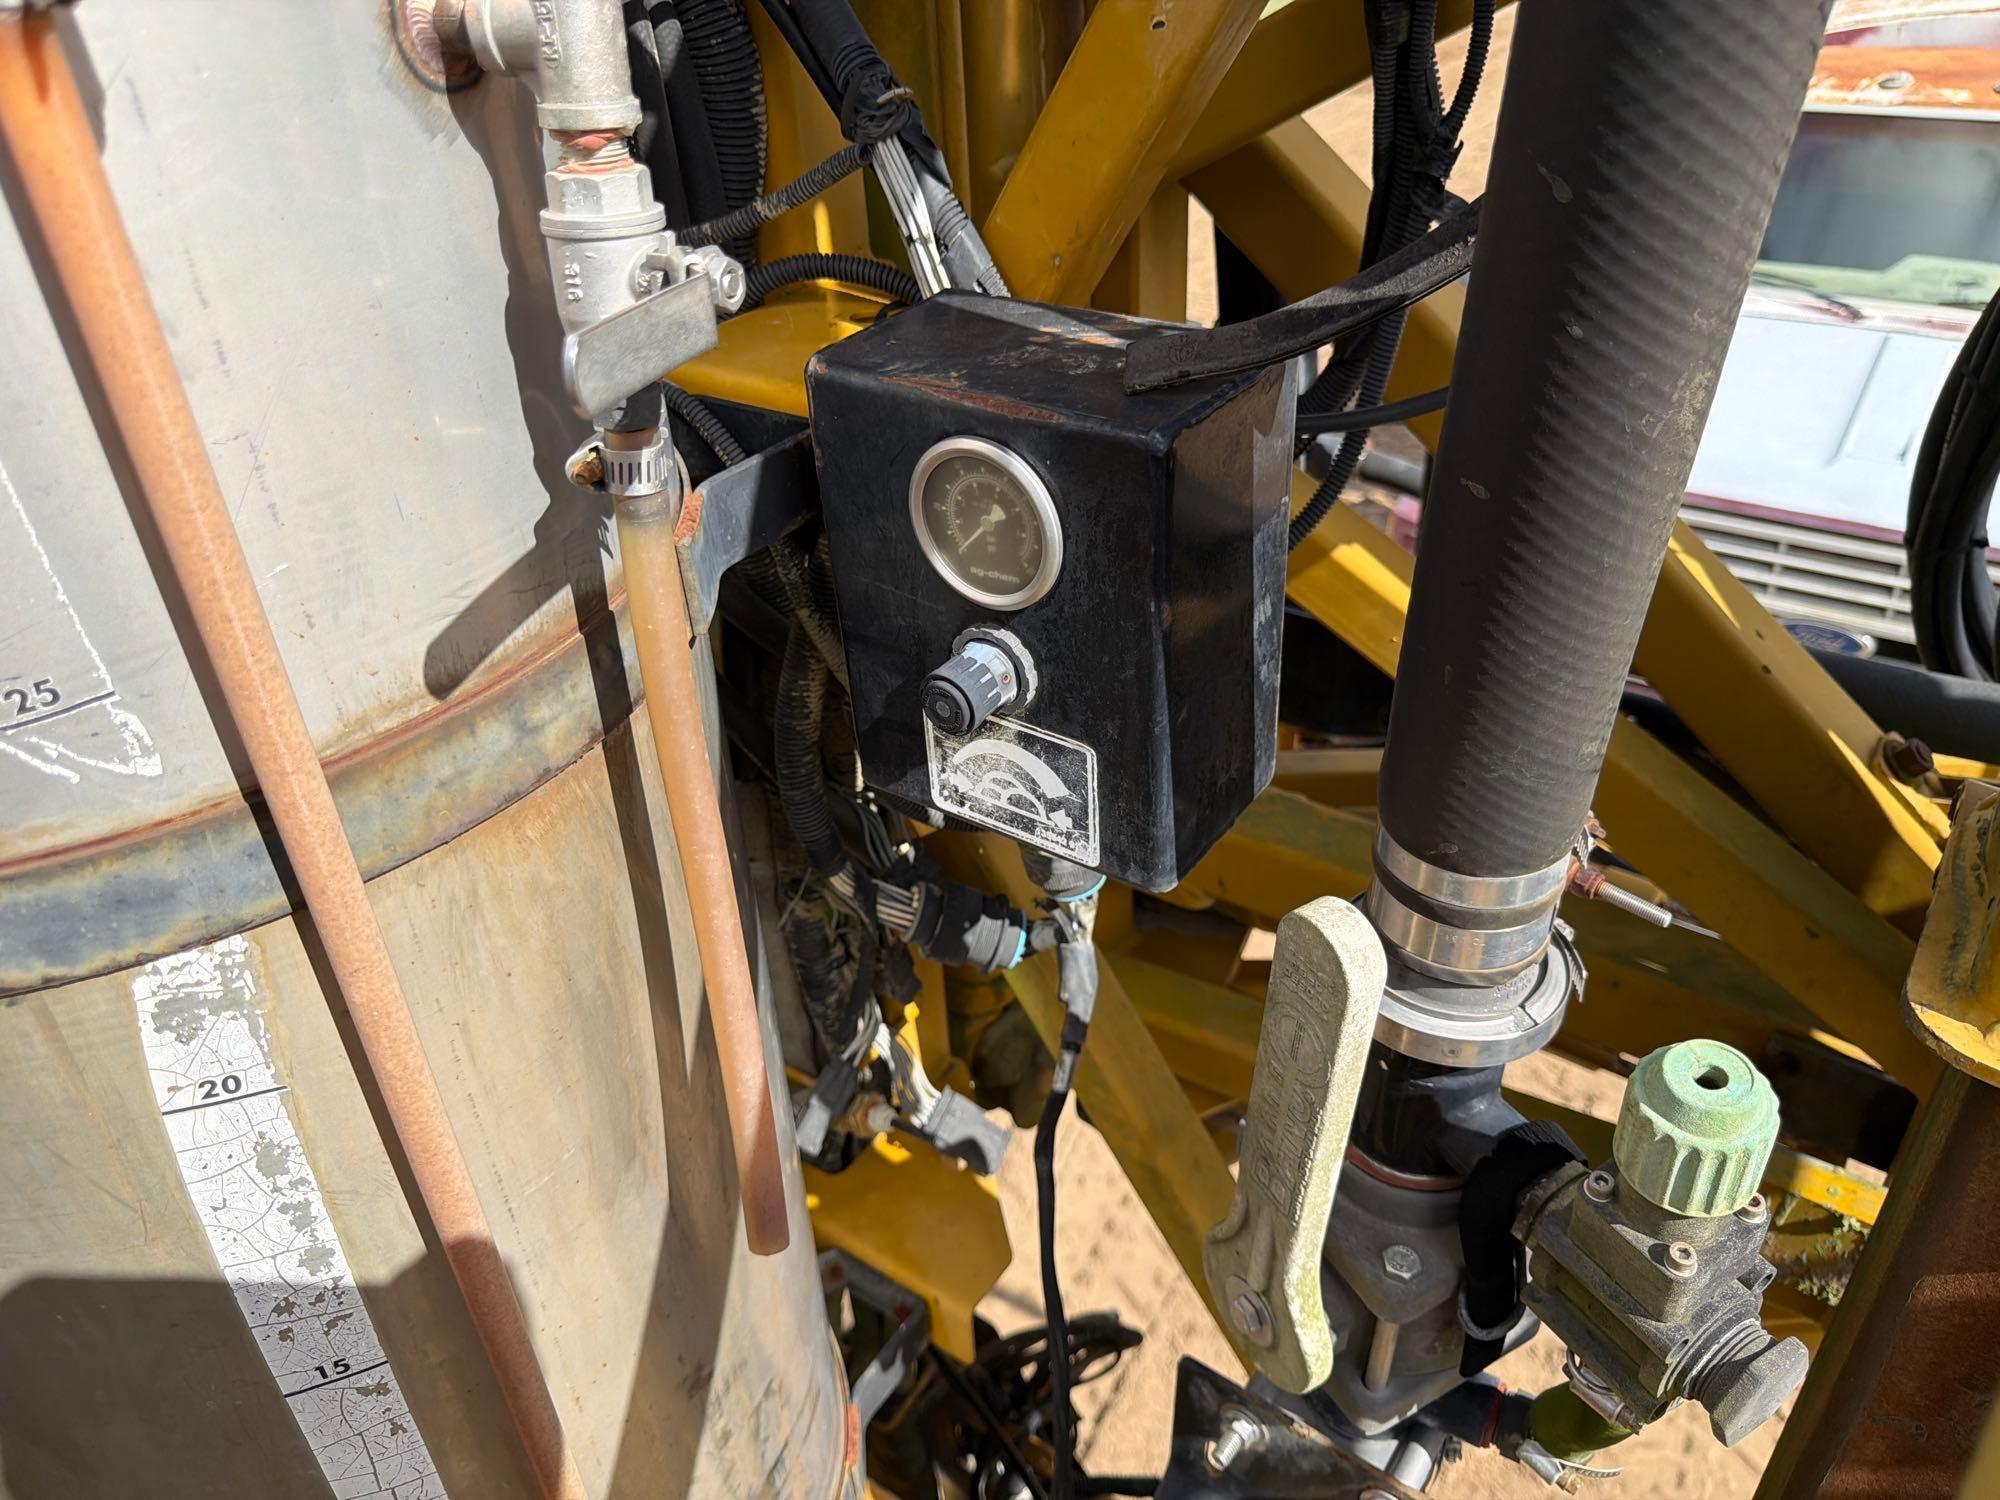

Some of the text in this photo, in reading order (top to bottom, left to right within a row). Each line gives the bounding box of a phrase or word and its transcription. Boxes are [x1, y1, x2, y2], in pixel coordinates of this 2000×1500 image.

[4, 678, 61, 716] 25
[198, 1074, 242, 1100] 20
[314, 1358, 351, 1379] 15
